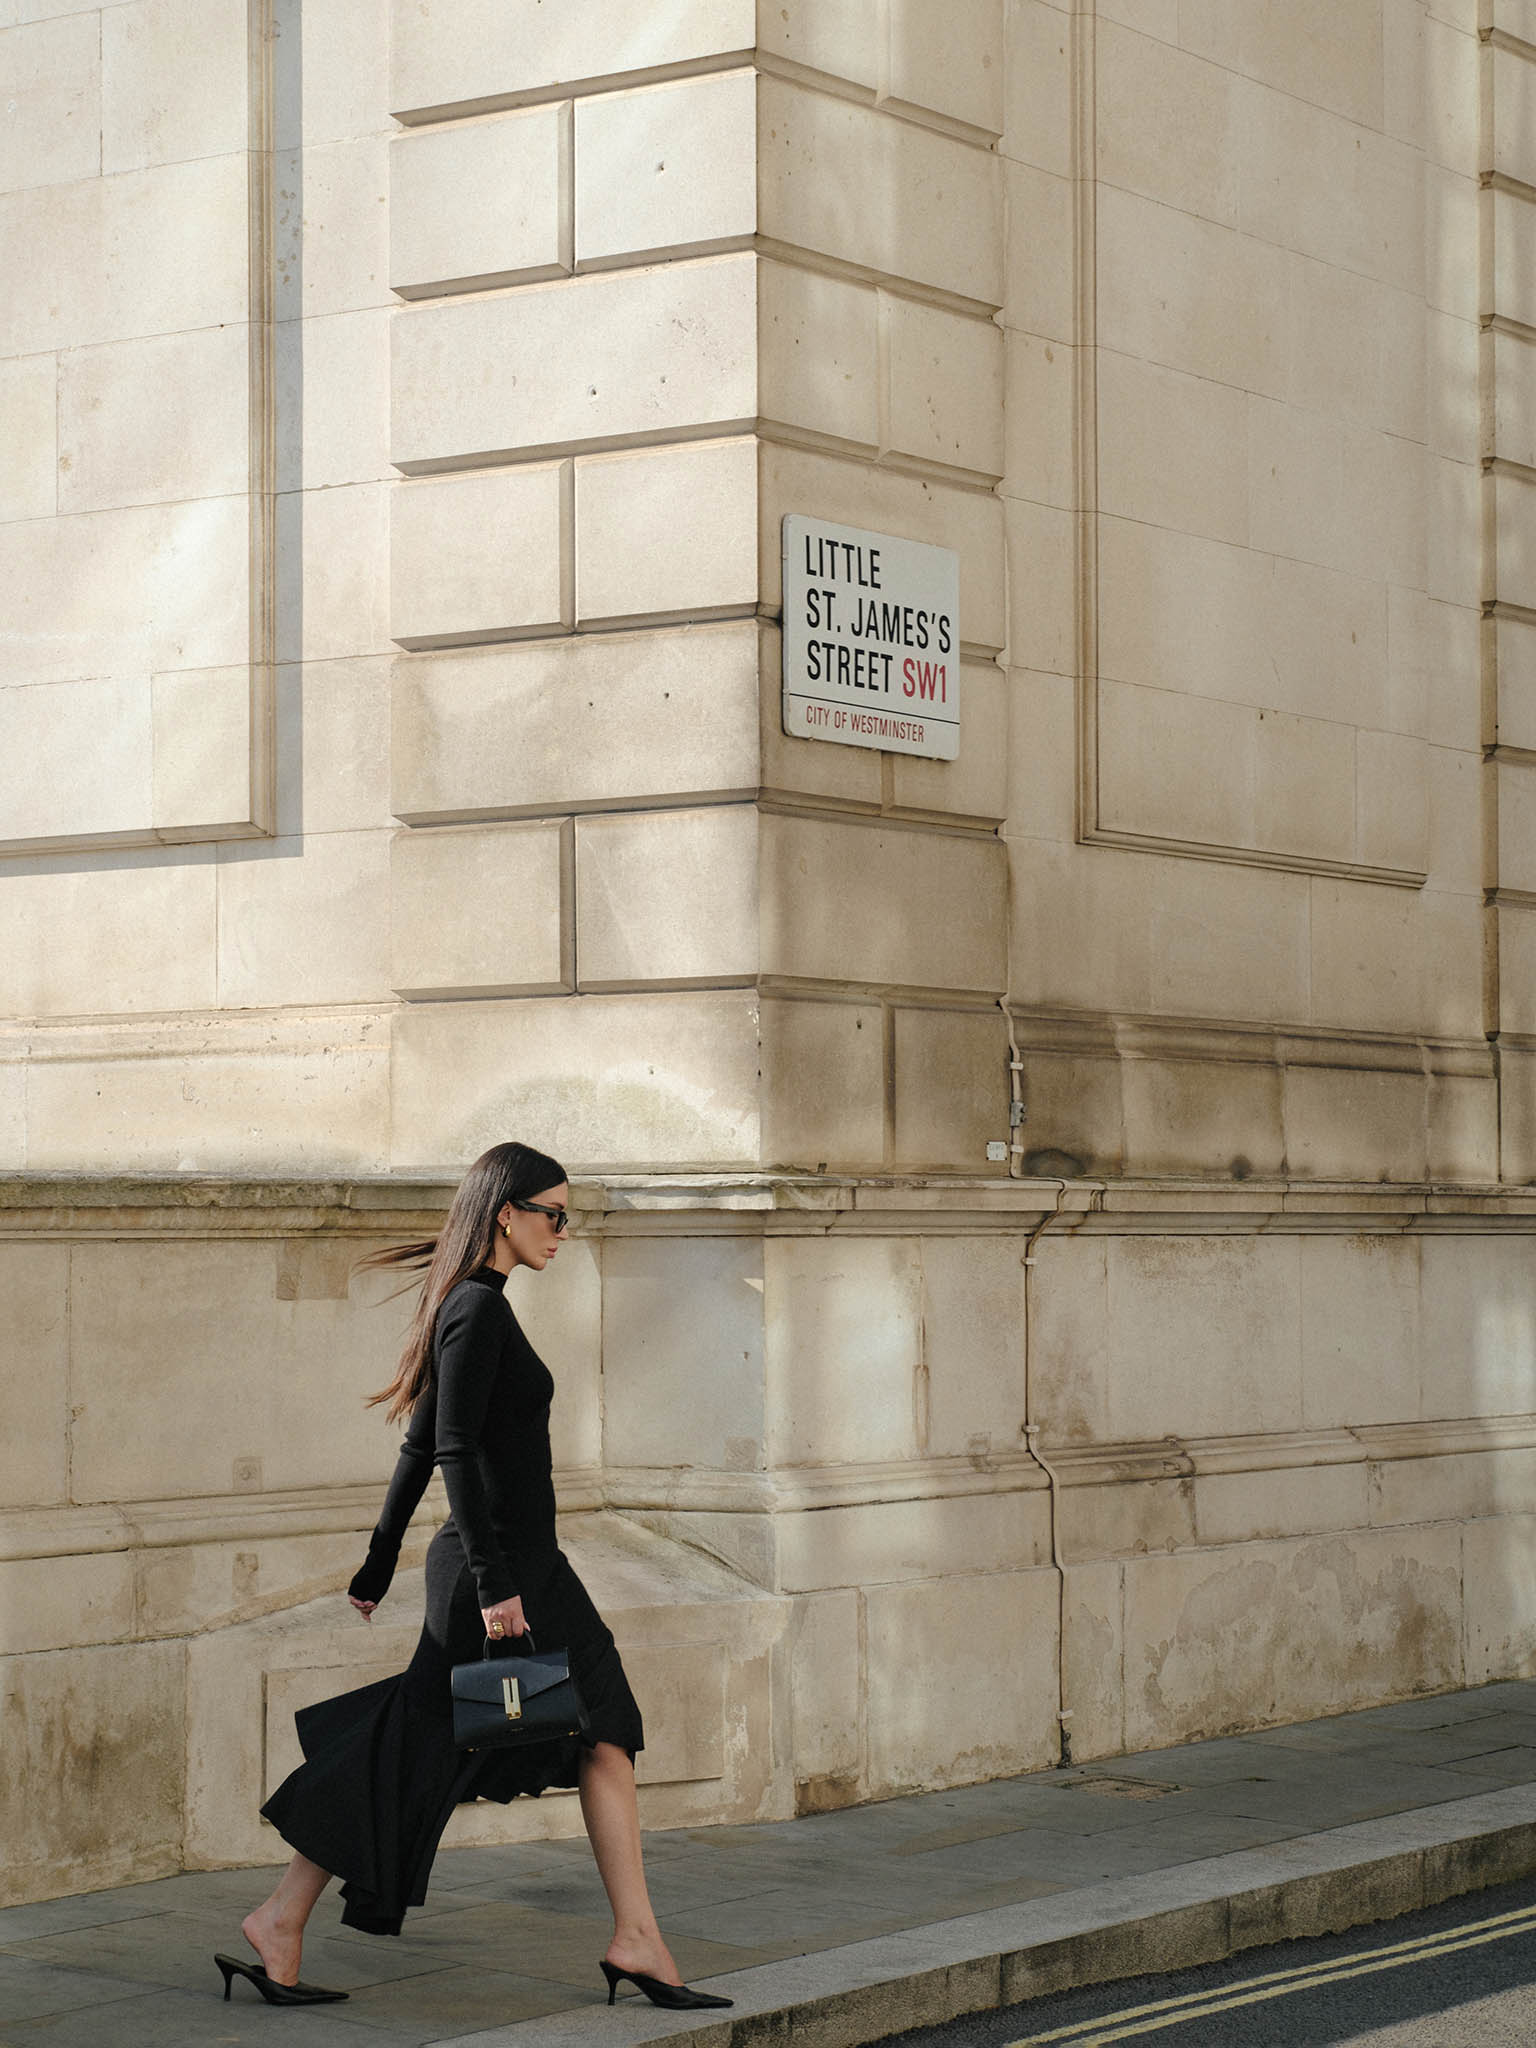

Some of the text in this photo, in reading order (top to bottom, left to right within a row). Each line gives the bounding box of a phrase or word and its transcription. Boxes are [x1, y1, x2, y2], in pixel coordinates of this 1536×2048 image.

[806, 535, 881, 589] LITTLE
[806, 588, 950, 654] ST. JAMES'S
[807, 639, 946, 703] STREET SW1
[806, 705, 924, 743] CITY OF WESTMINSTER
